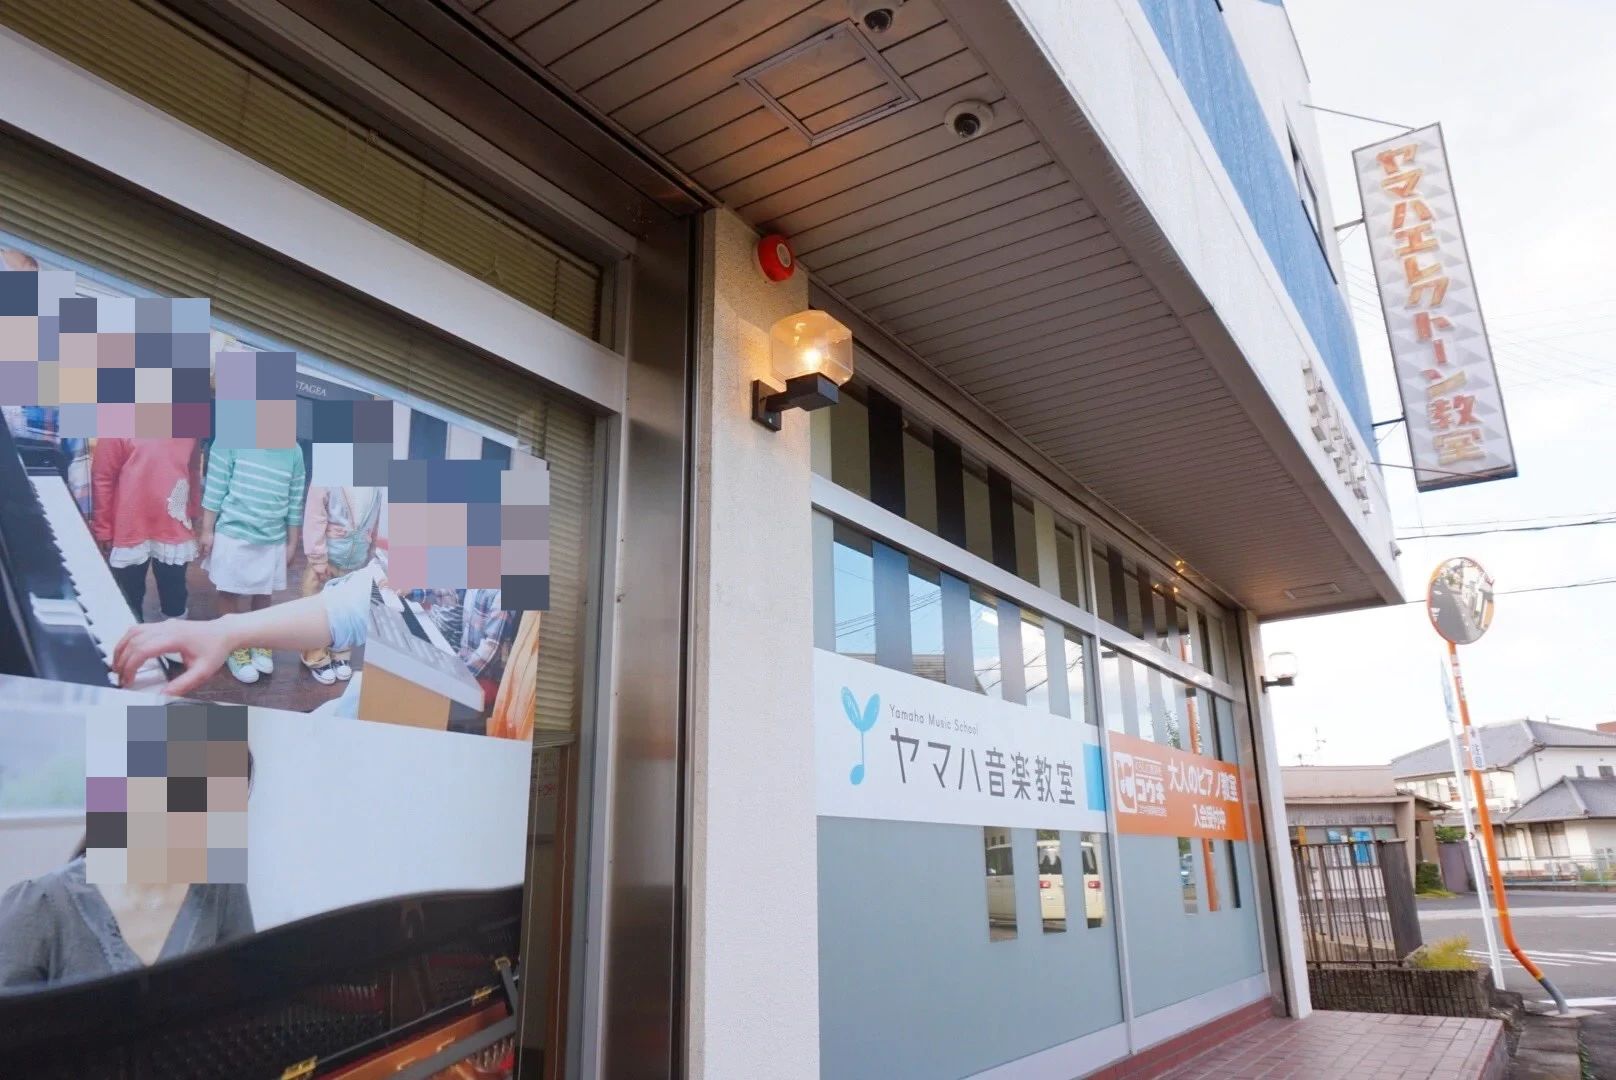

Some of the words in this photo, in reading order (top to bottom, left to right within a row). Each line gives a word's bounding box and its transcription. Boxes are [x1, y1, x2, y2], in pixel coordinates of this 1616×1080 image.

[1376, 143, 1486, 465] ヤマハエレクトーン教室
[889, 703, 924, 724] Yamaha
[928, 713, 951, 730] Music
[953, 718, 979, 737] School
[890, 727, 1076, 805] ヤマハ音楽教室
[1167, 757, 1239, 803] 大人のピアノ教室
